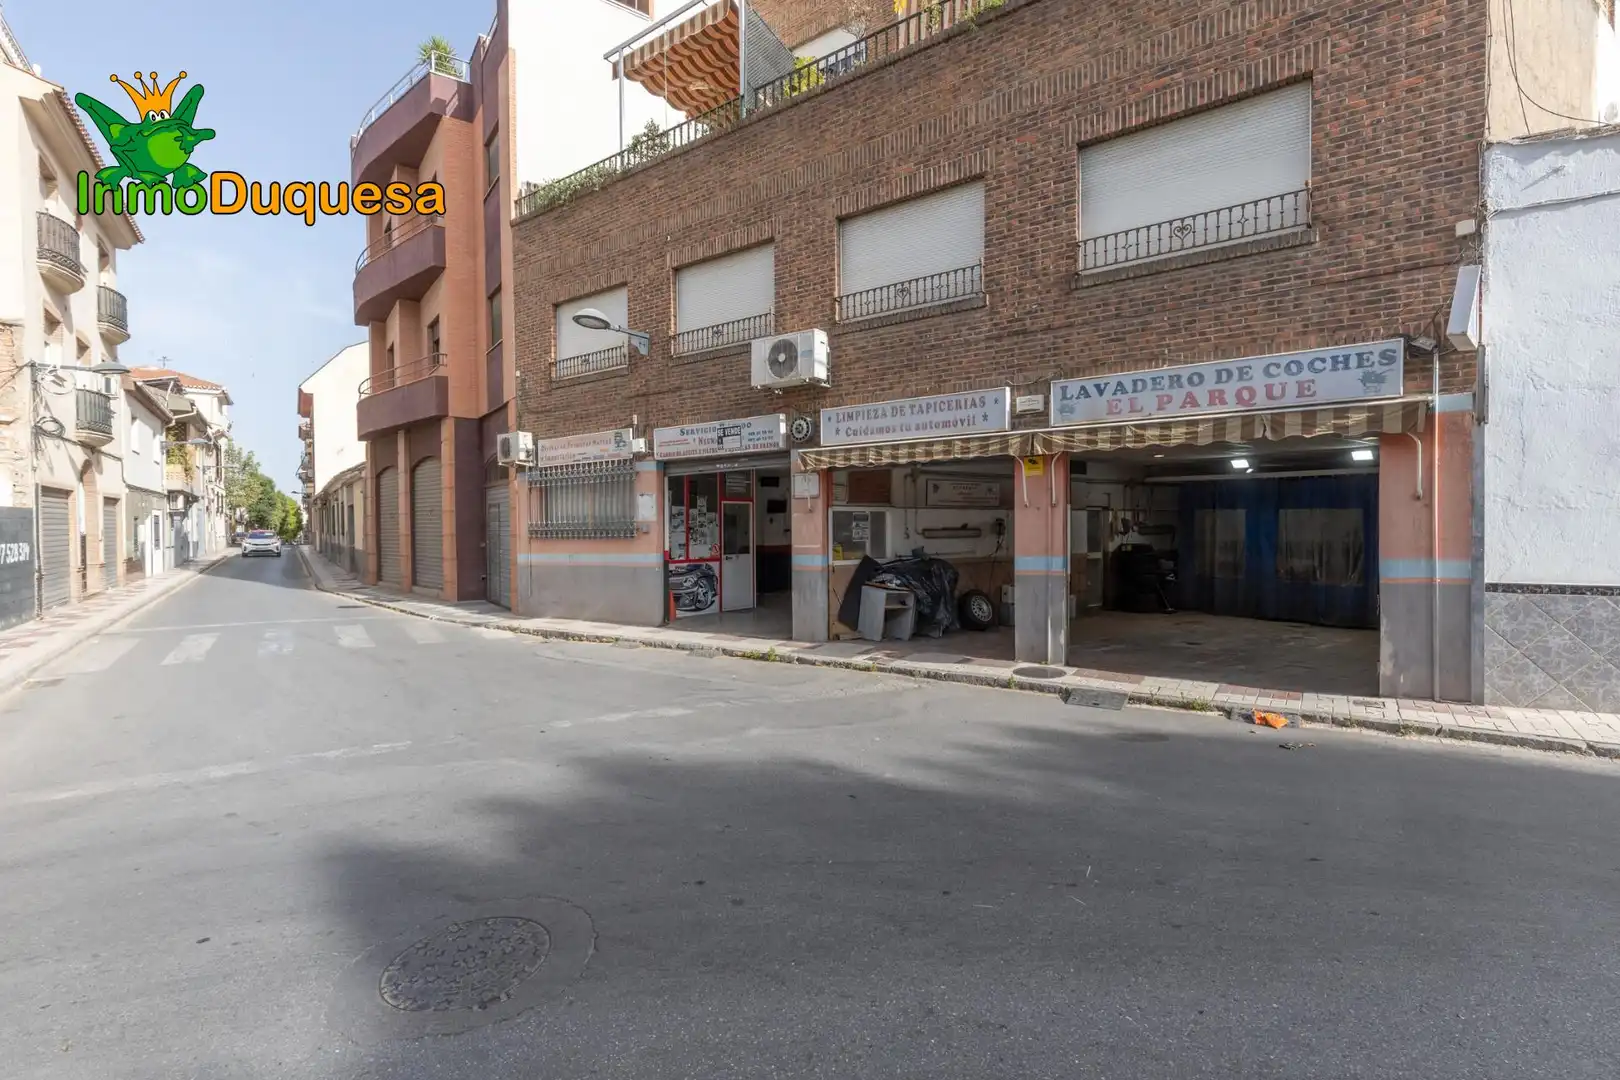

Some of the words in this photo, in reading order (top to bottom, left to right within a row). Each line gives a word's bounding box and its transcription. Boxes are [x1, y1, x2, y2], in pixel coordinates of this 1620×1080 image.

[1060, 371, 1205, 401] LAVADERO
[1214, 365, 1254, 385] DE
[1262, 348, 1397, 379] COCHES
[835, 409, 888, 424] LIMPIEZA
[891, 405, 906, 418] DE
[908, 395, 986, 416] TAPICERIAS
[1106, 397, 1144, 416] EL
[1156, 378, 1317, 411] PARQUE
[717, 429, 724, 437] SE
[724, 427, 741, 436] VENDE
[845, 422, 897, 437] Cuidamos
[914, 413, 976, 432] automóvil
